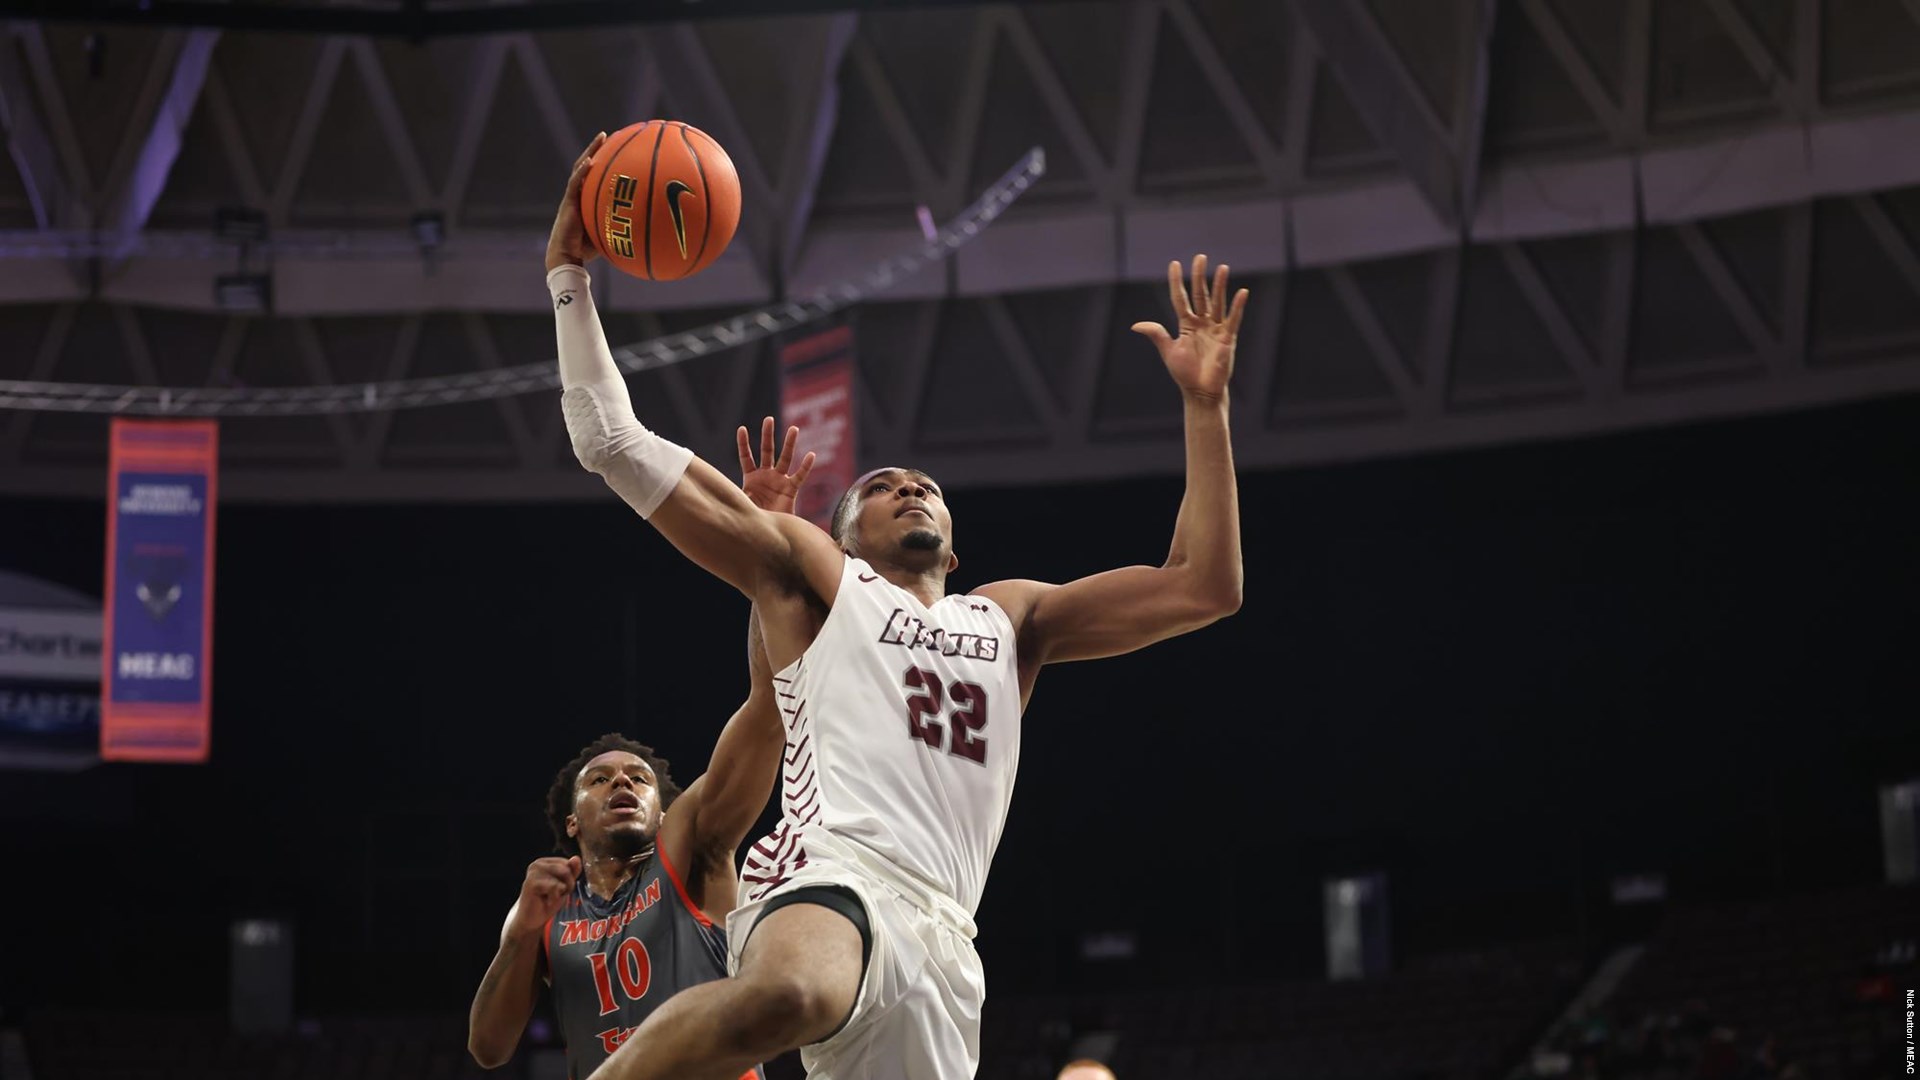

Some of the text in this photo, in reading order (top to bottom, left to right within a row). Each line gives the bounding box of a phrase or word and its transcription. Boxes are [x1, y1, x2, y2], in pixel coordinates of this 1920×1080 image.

[610, 174, 638, 260] ELITE
[118, 652, 195, 680] MEAC
[879, 608, 998, 662] HAWKS
[902, 663, 989, 768] 22
[585, 936, 652, 1016] 10
